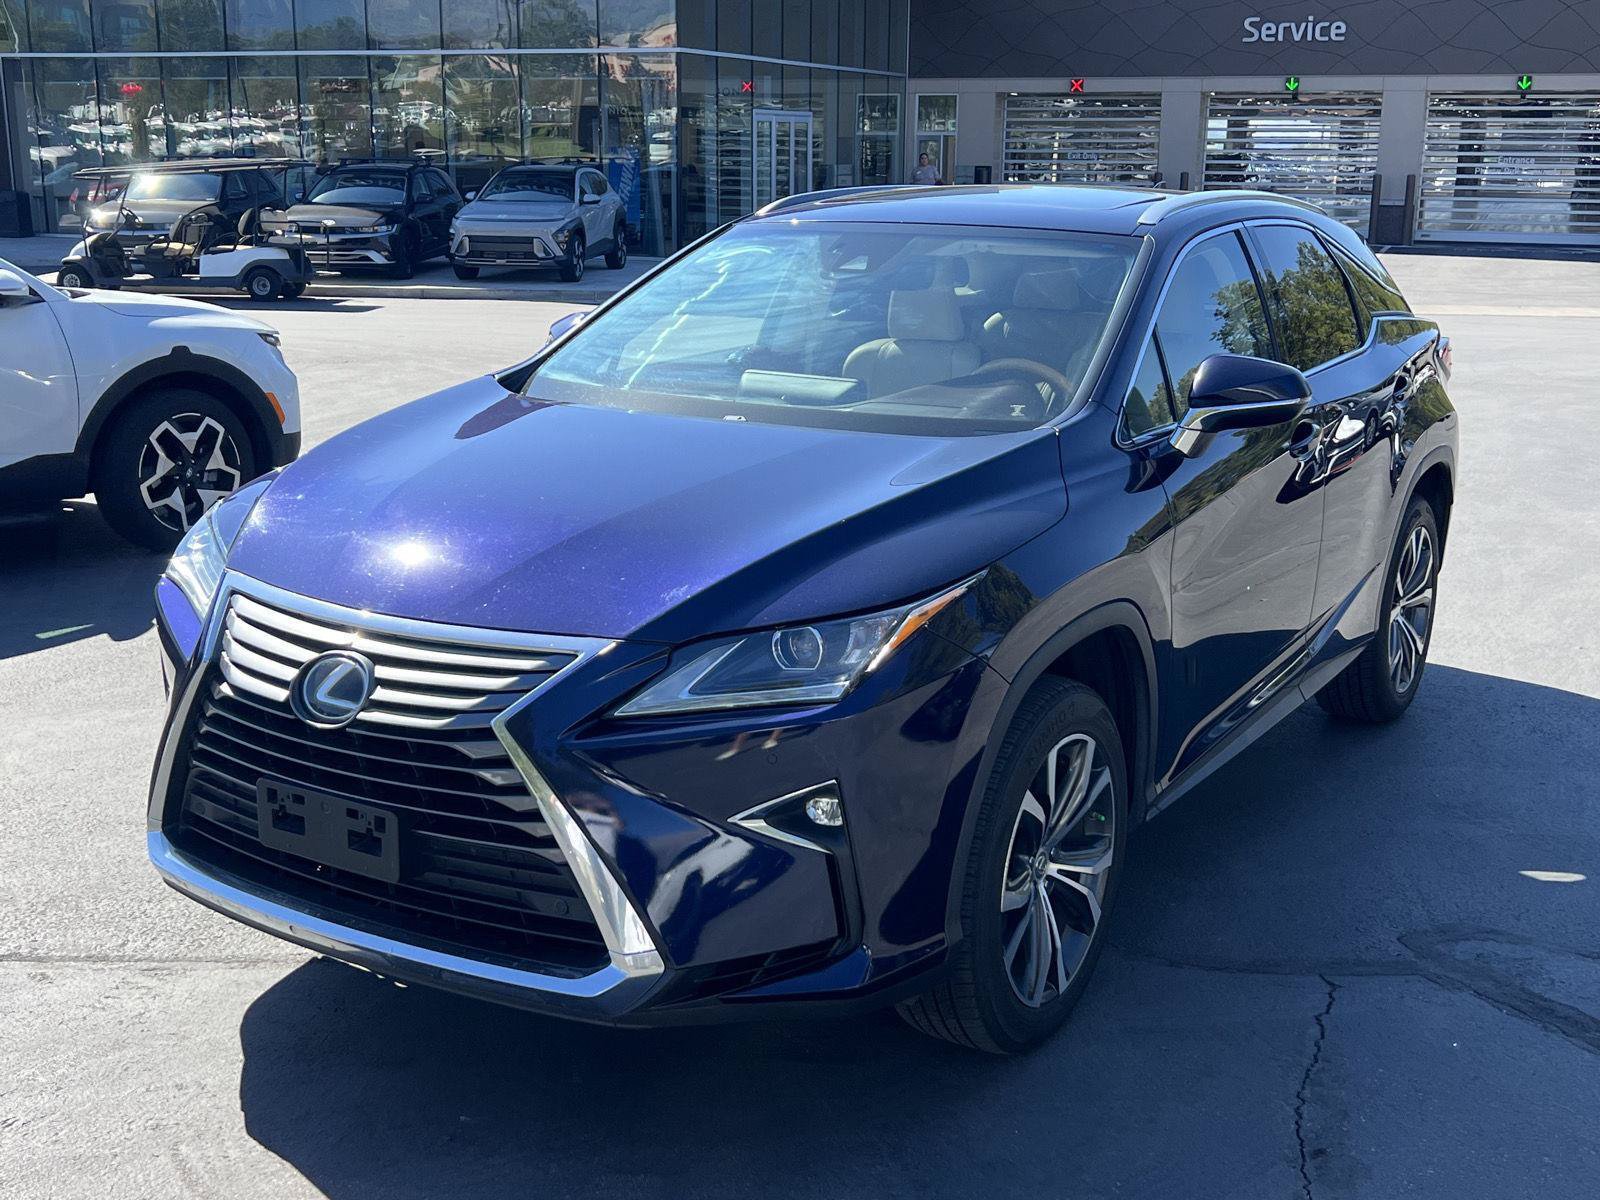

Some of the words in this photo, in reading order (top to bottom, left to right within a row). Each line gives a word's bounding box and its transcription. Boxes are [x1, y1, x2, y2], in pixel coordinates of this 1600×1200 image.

[1242, 15, 1347, 42] Service
[1067, 152, 1080, 160] Exit
[1083, 152, 1098, 160] Only
[1498, 156, 1535, 165] Entrance
